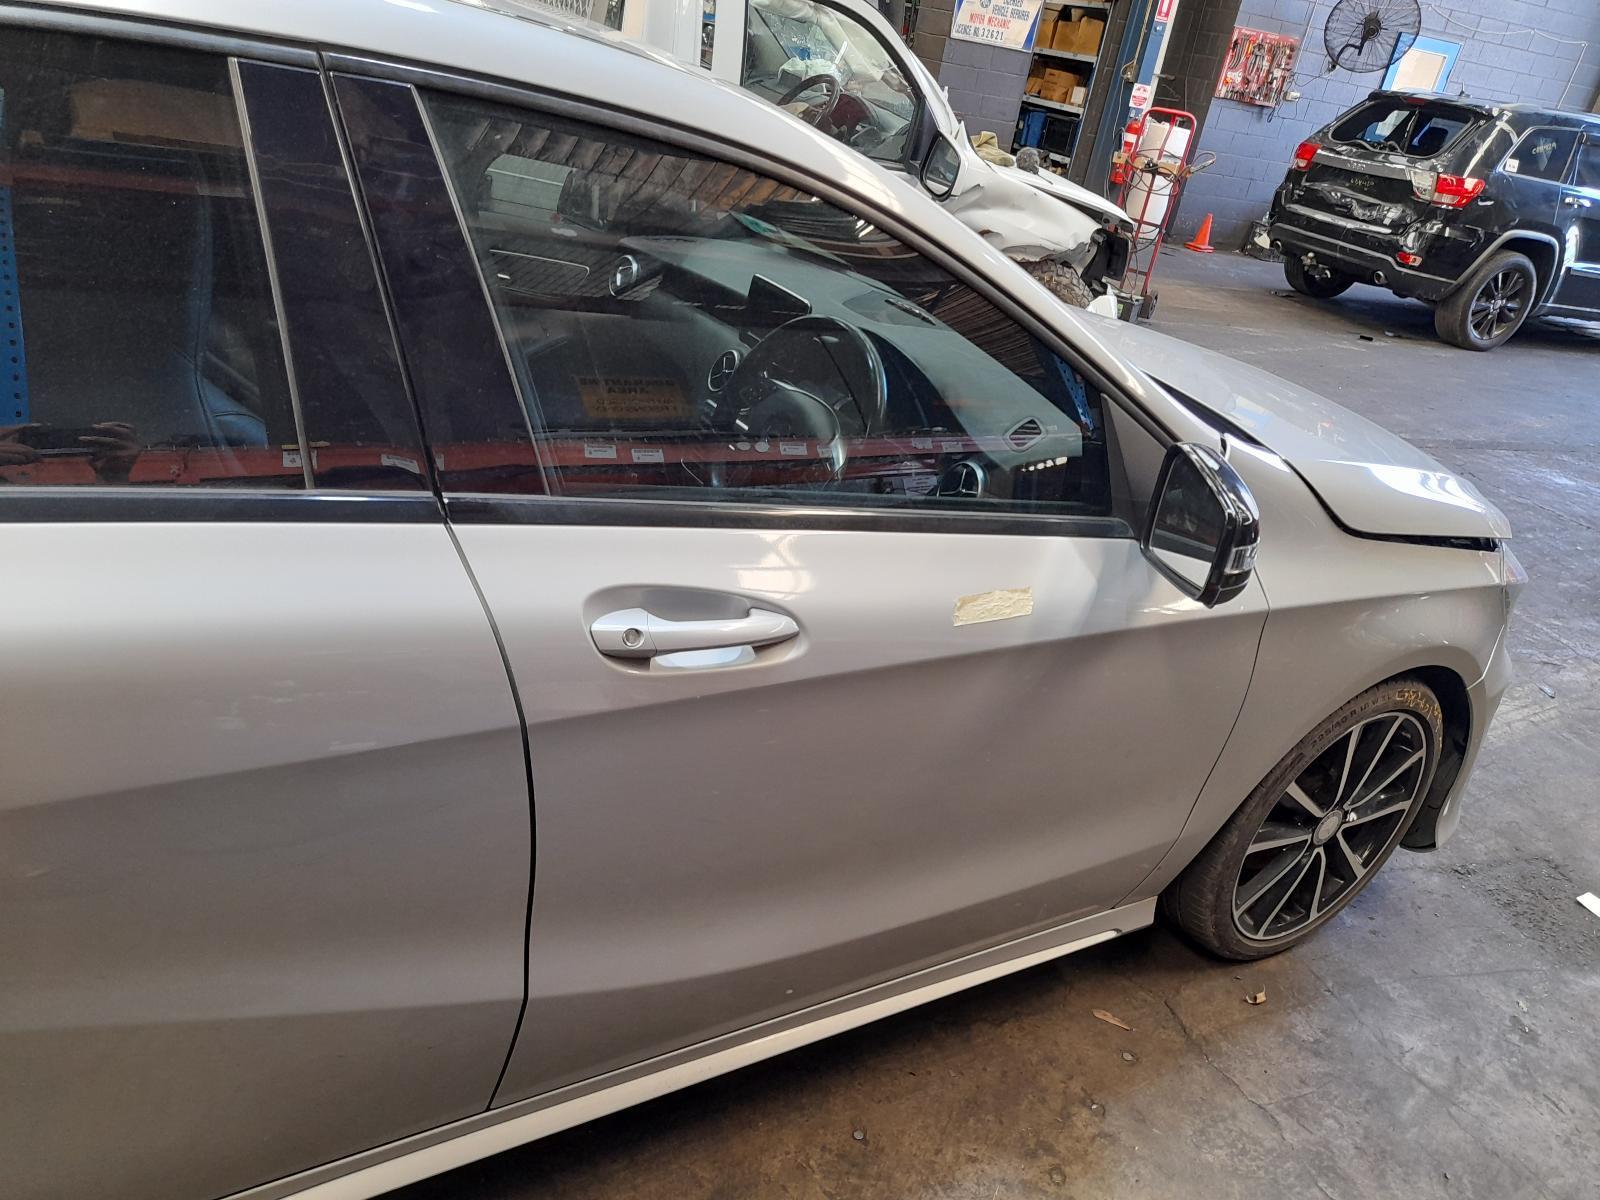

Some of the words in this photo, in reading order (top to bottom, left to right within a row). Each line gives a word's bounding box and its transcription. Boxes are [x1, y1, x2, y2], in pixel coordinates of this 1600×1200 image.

[992, 4, 1009, 17] VEHICLE
[969, 12, 986, 25] MOTOR
[987, 14, 1011, 29] MECHANIC
[981, 27, 1004, 40] 32621
